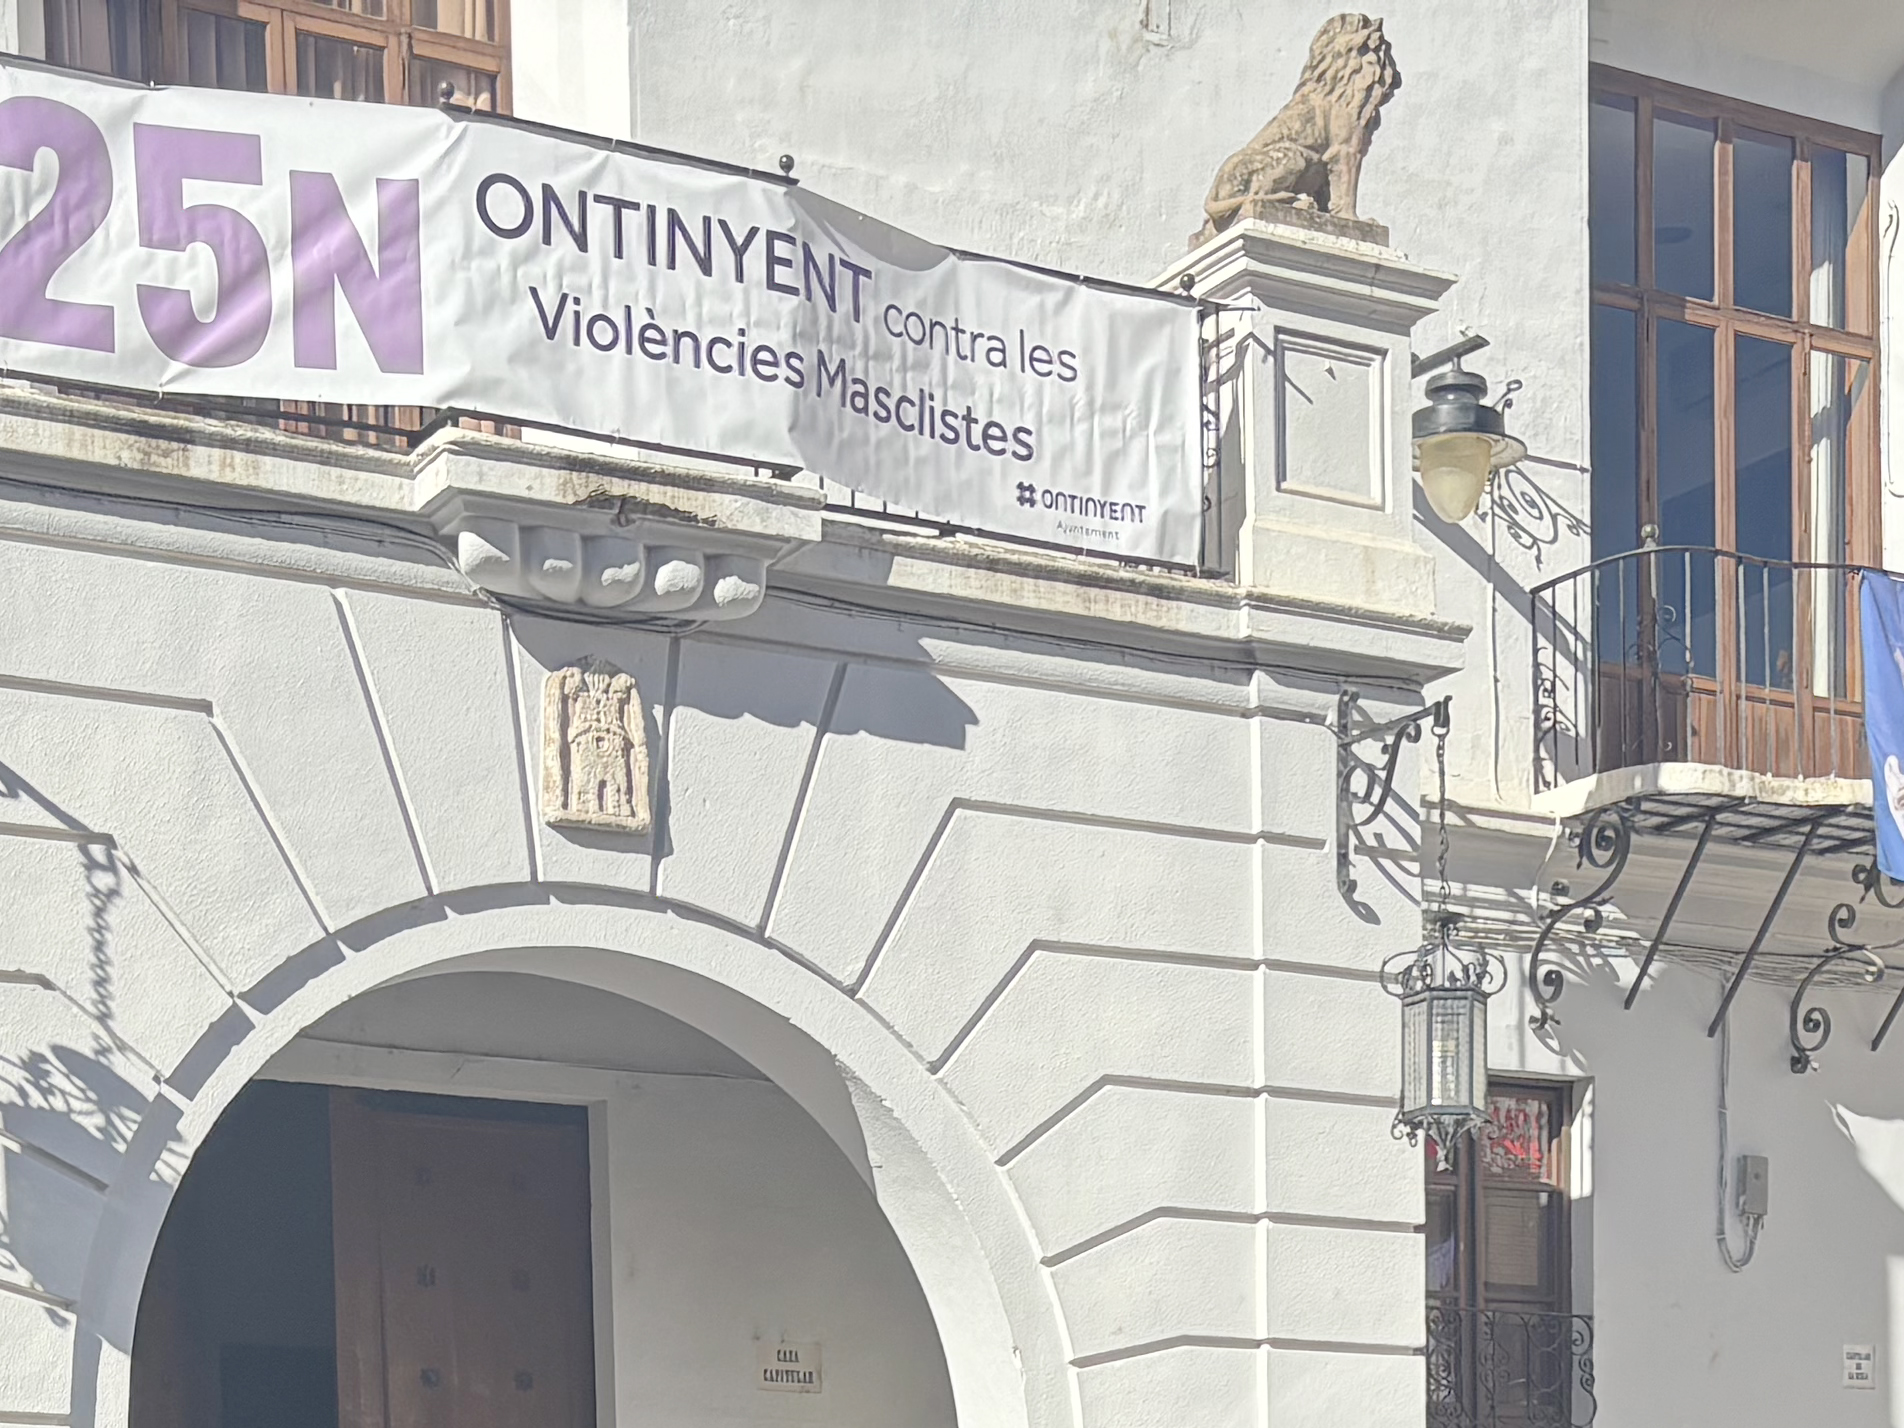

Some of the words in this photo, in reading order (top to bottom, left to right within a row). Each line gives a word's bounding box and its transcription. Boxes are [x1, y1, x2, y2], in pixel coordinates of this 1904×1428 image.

[476, 173, 872, 323] ONTINYENT
[882, 304, 1007, 369] contra
[1018, 330, 1079, 384] les
[530, 286, 805, 390] Violències
[816, 348, 1036, 462] Masclistes
